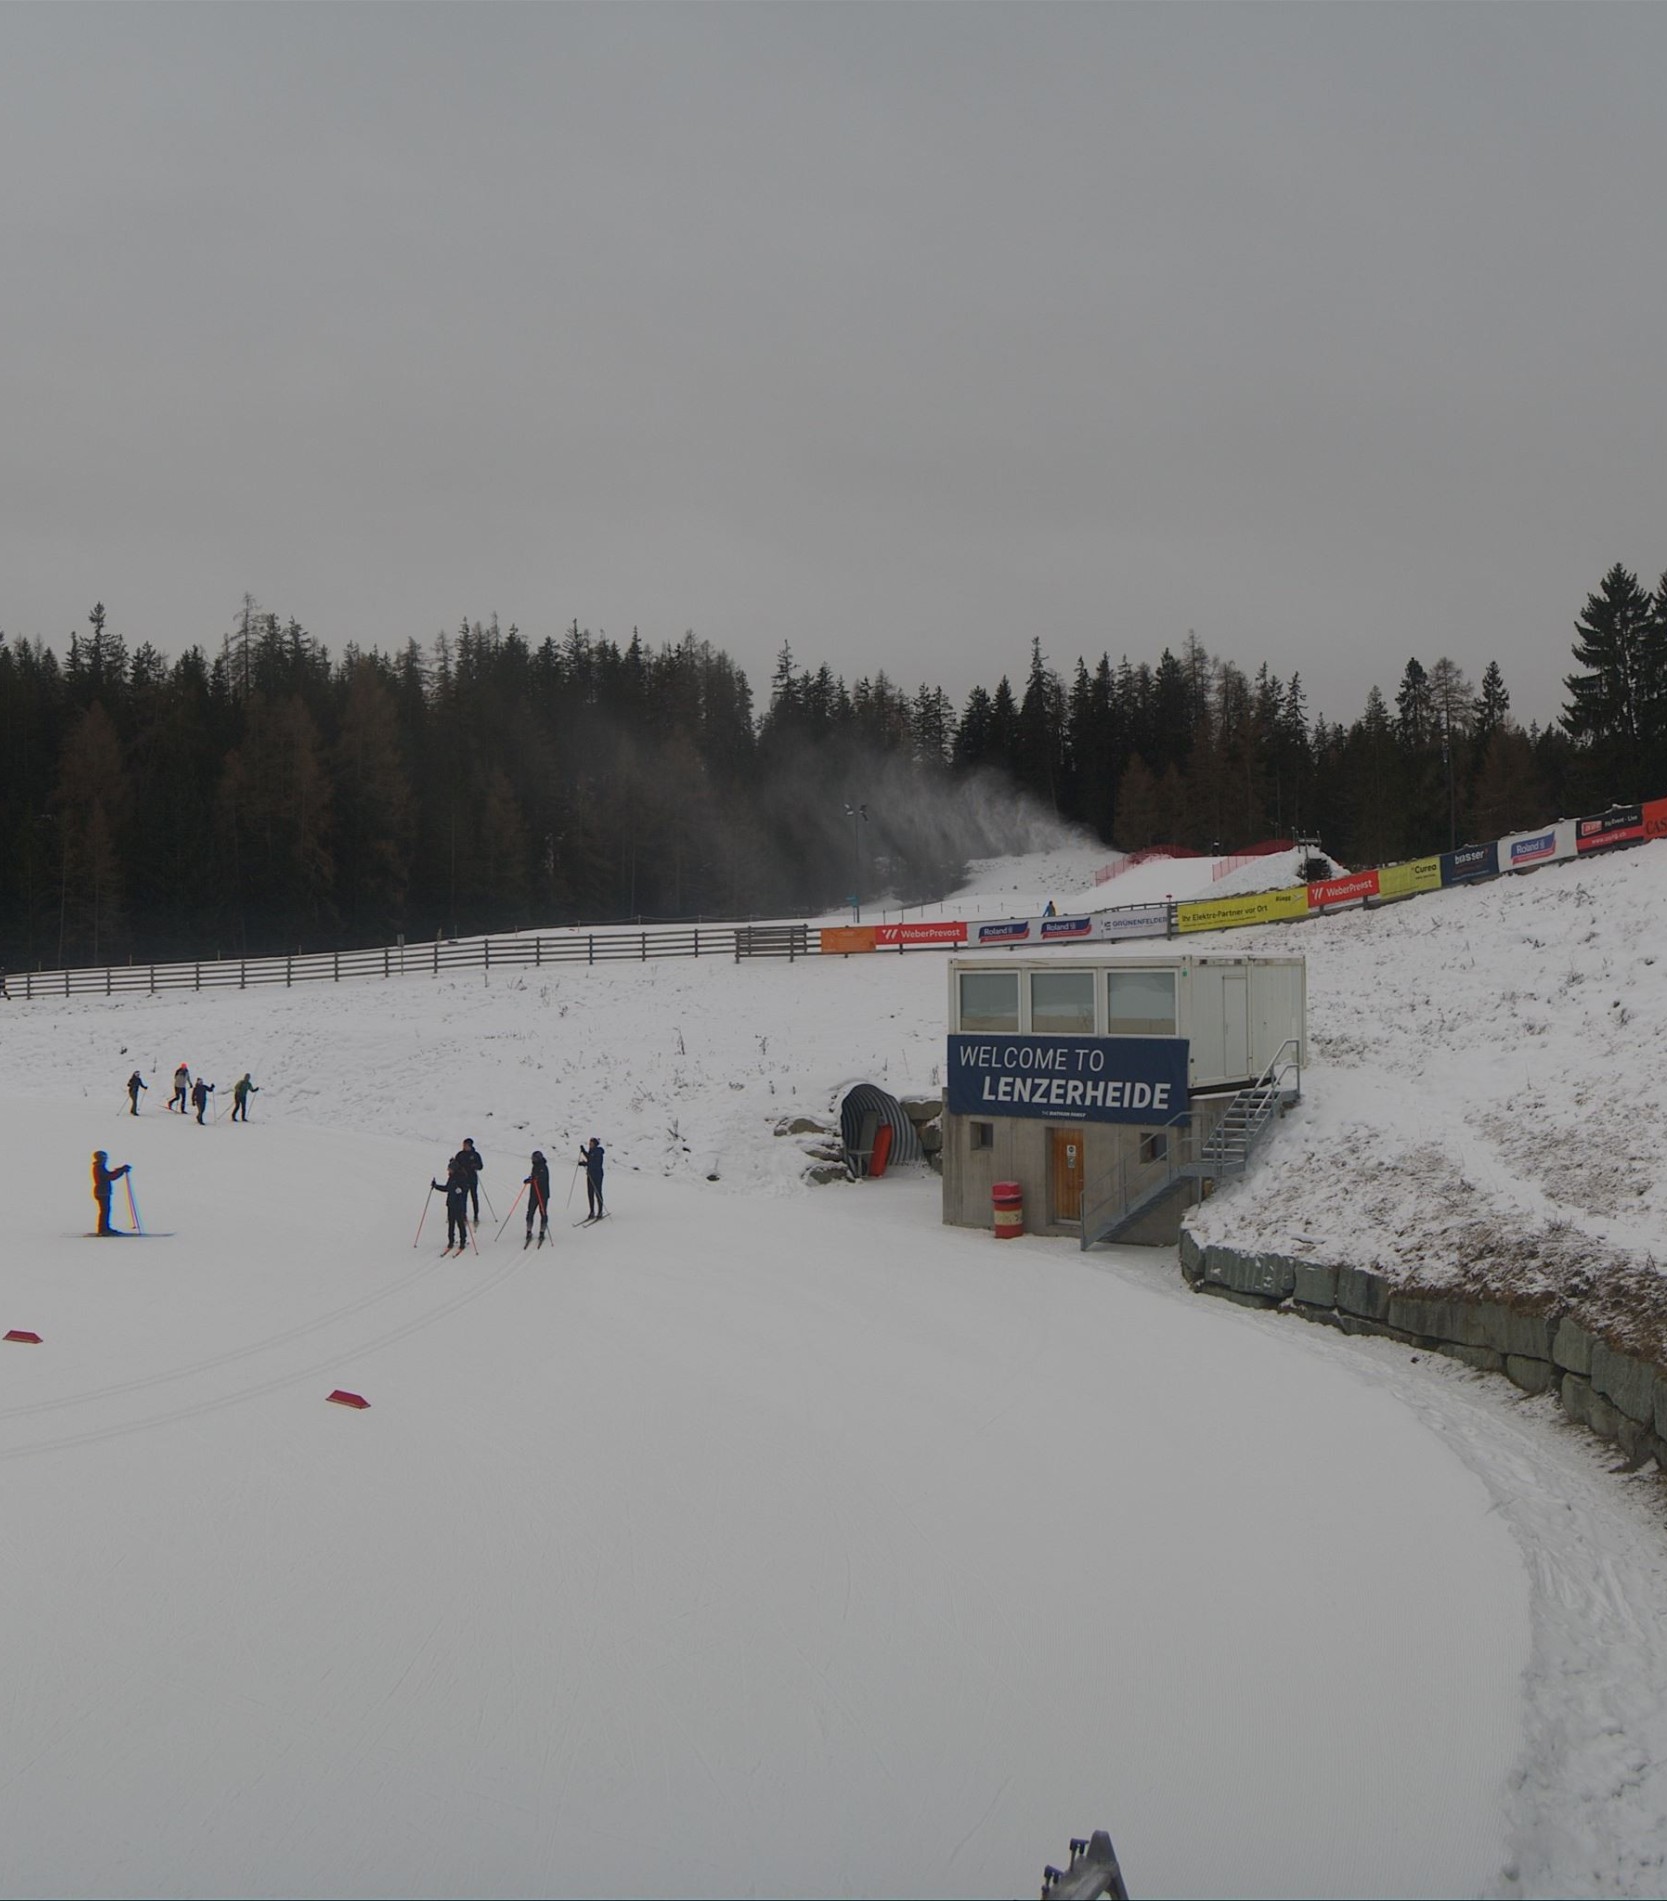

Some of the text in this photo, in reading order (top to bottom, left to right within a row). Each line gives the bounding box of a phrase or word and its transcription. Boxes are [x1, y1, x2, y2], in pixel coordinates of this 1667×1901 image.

[1516, 843, 1539, 854] Roland
[1326, 880, 1373, 897] WeberPrevost
[1193, 909, 1243, 922] Elektro-Partner
[1257, 905, 1268, 913] Ort
[901, 928, 960, 939] WeberPrevost
[984, 926, 1008, 935] Roland
[1046, 922, 1071, 931] Roland
[960, 1045, 1104, 1072] WELCOME TO
[982, 1076, 1172, 1110] LENZERHEIDE
